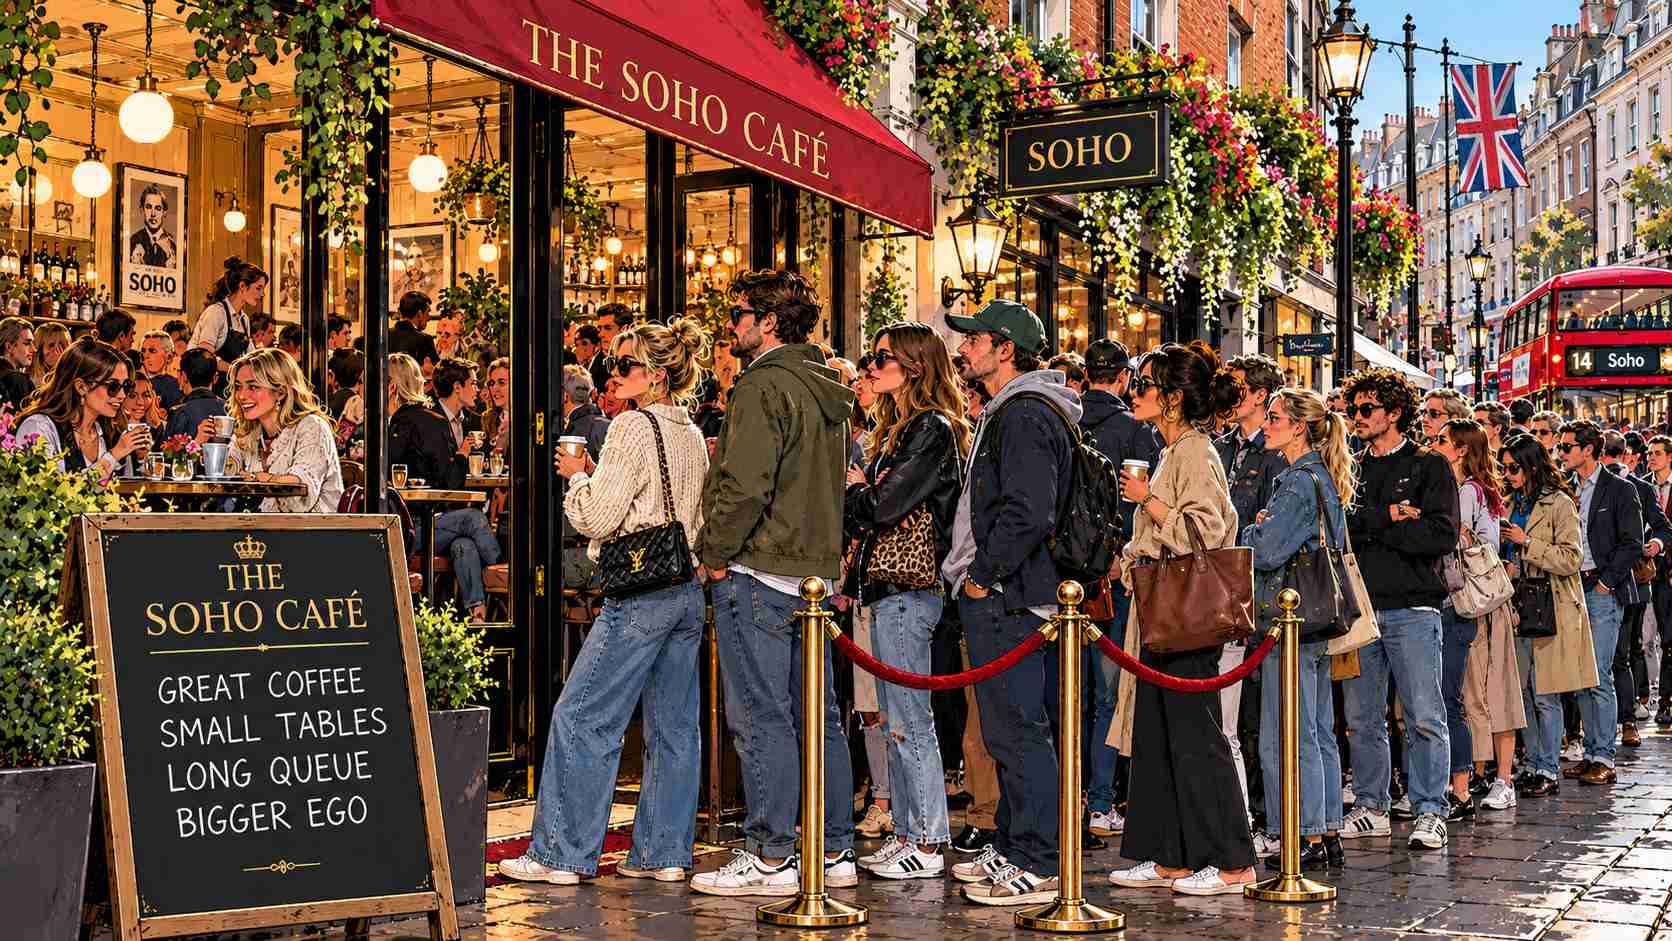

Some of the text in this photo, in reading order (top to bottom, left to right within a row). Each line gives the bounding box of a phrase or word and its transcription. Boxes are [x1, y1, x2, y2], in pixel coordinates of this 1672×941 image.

[522, 18, 830, 179] THE SOHO CAFÉ
[1028, 131, 1132, 172] SOHO
[129, 272, 177, 294] SOHO
[1572, 351, 1645, 370] 14 Soho
[218, 563, 285, 591] THE
[146, 589, 368, 636] SOHO CAFÉ
[158, 666, 365, 705] GREAT COFFEE
[160, 706, 387, 748] SMALL TABLES
[168, 750, 373, 793] LONG QUEUE
[176, 795, 368, 838] BIGGER EGO
